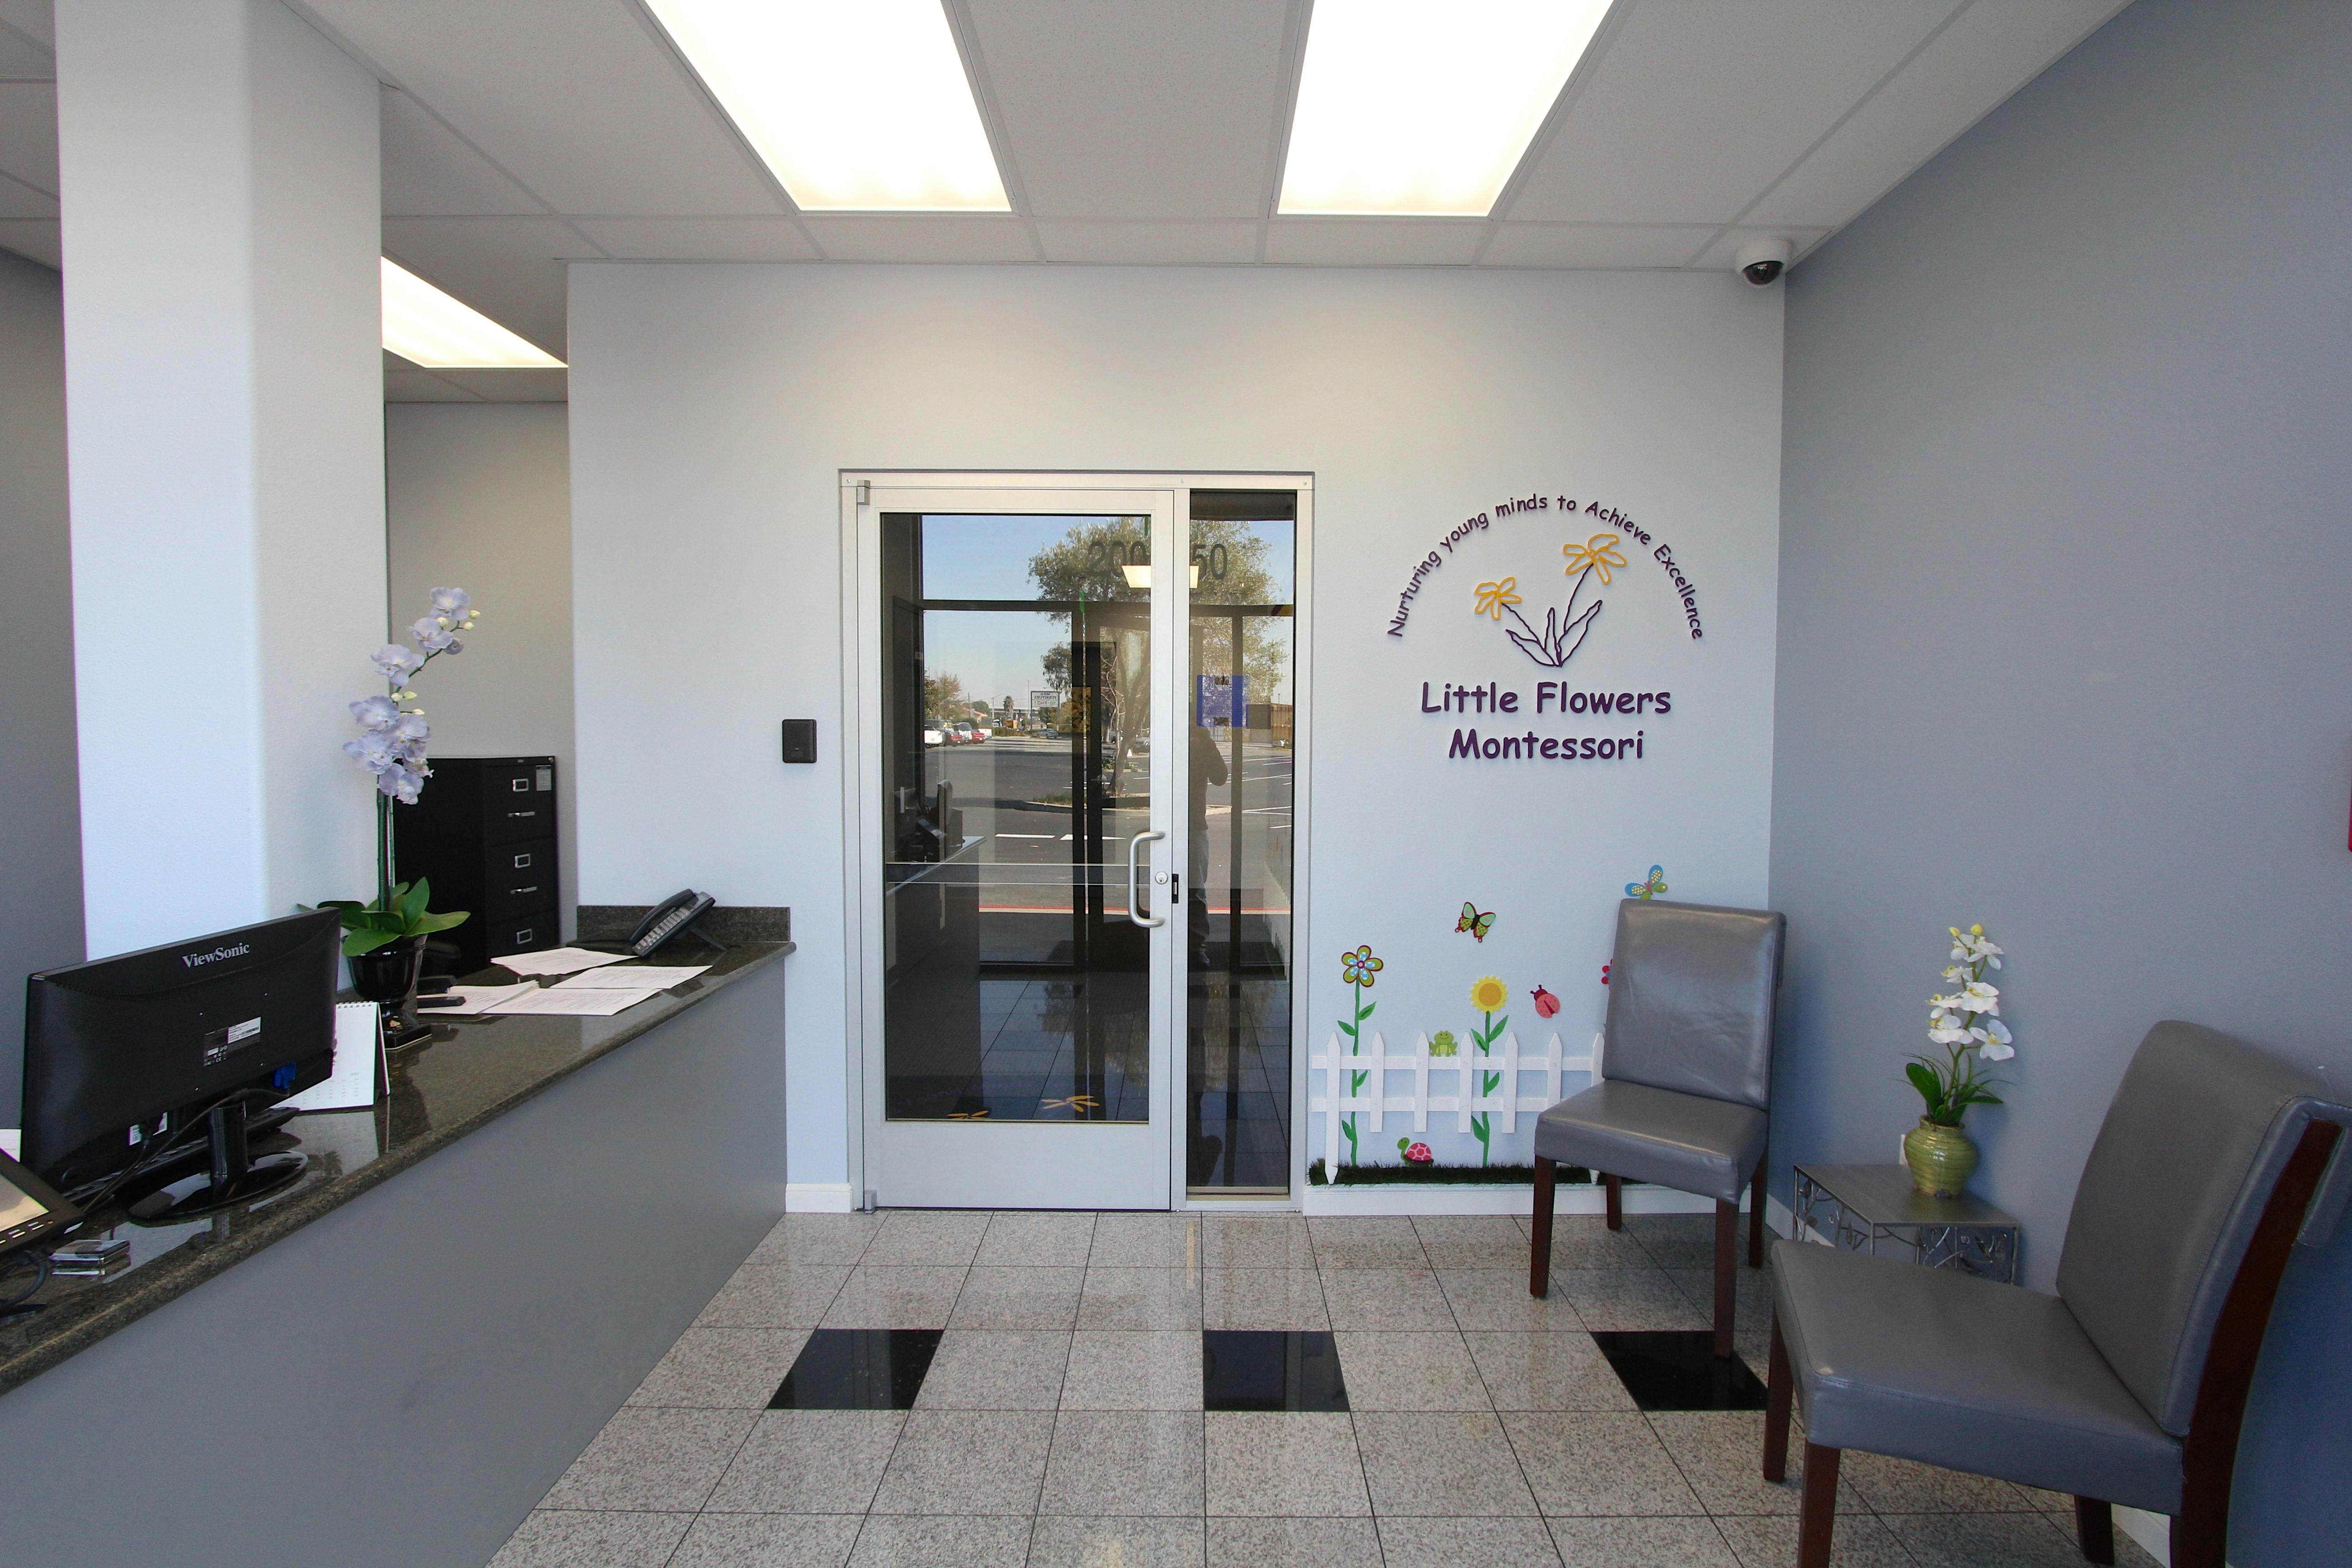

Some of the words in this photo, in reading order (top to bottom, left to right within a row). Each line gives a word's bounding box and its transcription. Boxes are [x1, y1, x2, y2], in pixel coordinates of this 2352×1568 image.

[1387, 551, 1442, 637] Nurturing
[1440, 513, 1489, 553] young
[1495, 493, 1548, 518] minds
[1557, 495, 1577, 511] to
[1584, 501, 1651, 545] Achieve
[1653, 544, 1703, 640] Excellence
[1421, 681, 1519, 713] Little
[1537, 681, 1671, 715] Flowers
[1449, 728, 1644, 760] Montessori
[181, 942, 250, 968] ViewSonic
